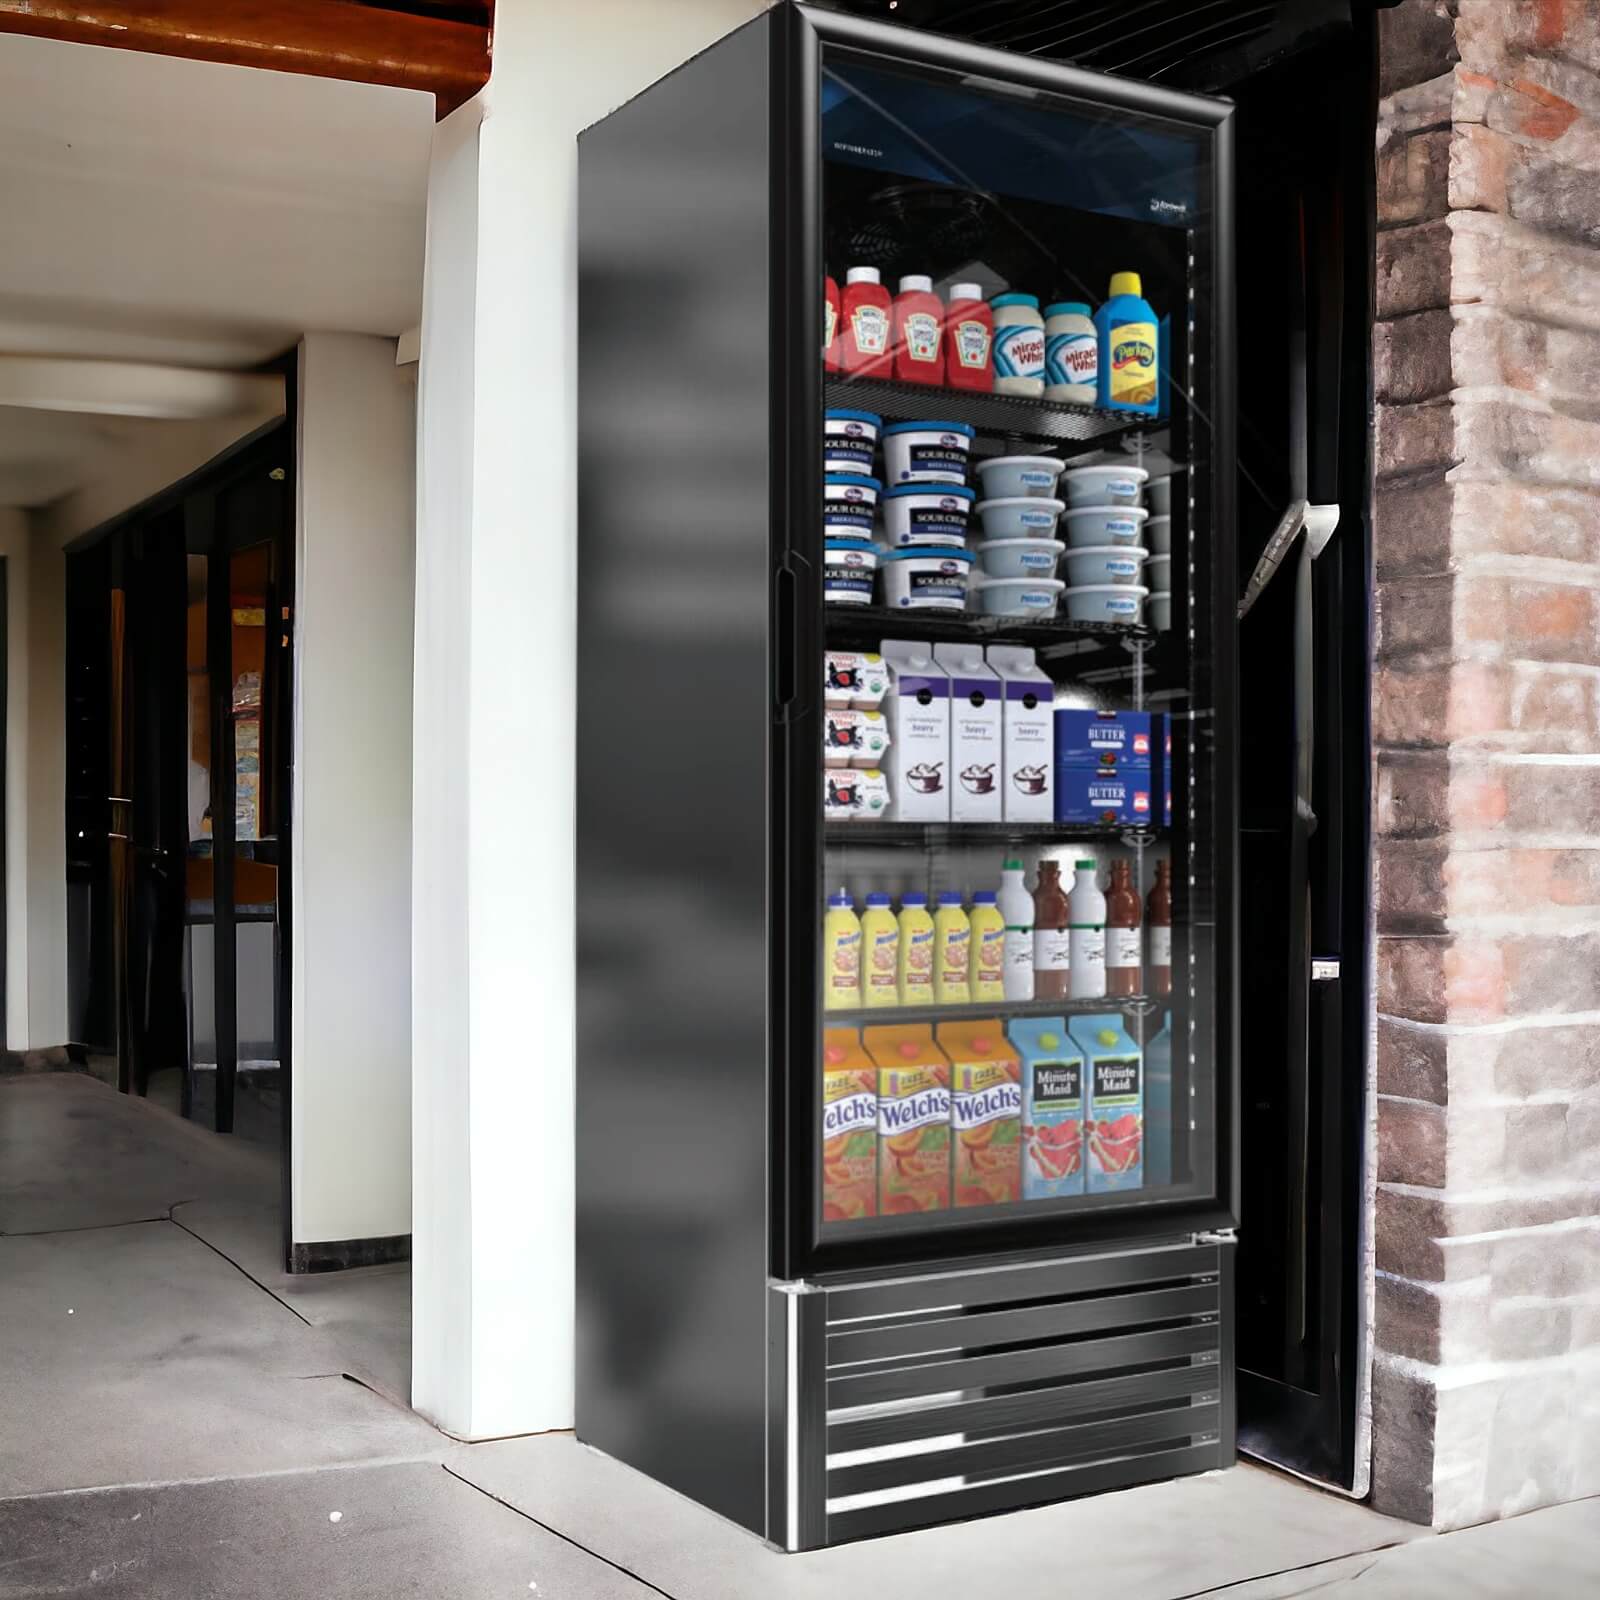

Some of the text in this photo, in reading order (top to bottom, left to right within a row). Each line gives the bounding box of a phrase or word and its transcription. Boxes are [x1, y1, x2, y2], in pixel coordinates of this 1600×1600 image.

[912, 724, 934, 733] heavy
[965, 725, 987, 734] heavy
[1088, 728, 1126, 740] BUTTER
[1088, 787, 1126, 799] BUTTER
[1037, 1070, 1077, 1084] Minute
[1098, 1067, 1136, 1080] Minute
[1043, 1083, 1072, 1096] Maid
[1103, 1078, 1131, 1091] Maid
[880, 1092, 949, 1129] Welch's
[953, 1088, 1021, 1123] Welch's
[824, 1097, 877, 1130] elch's
